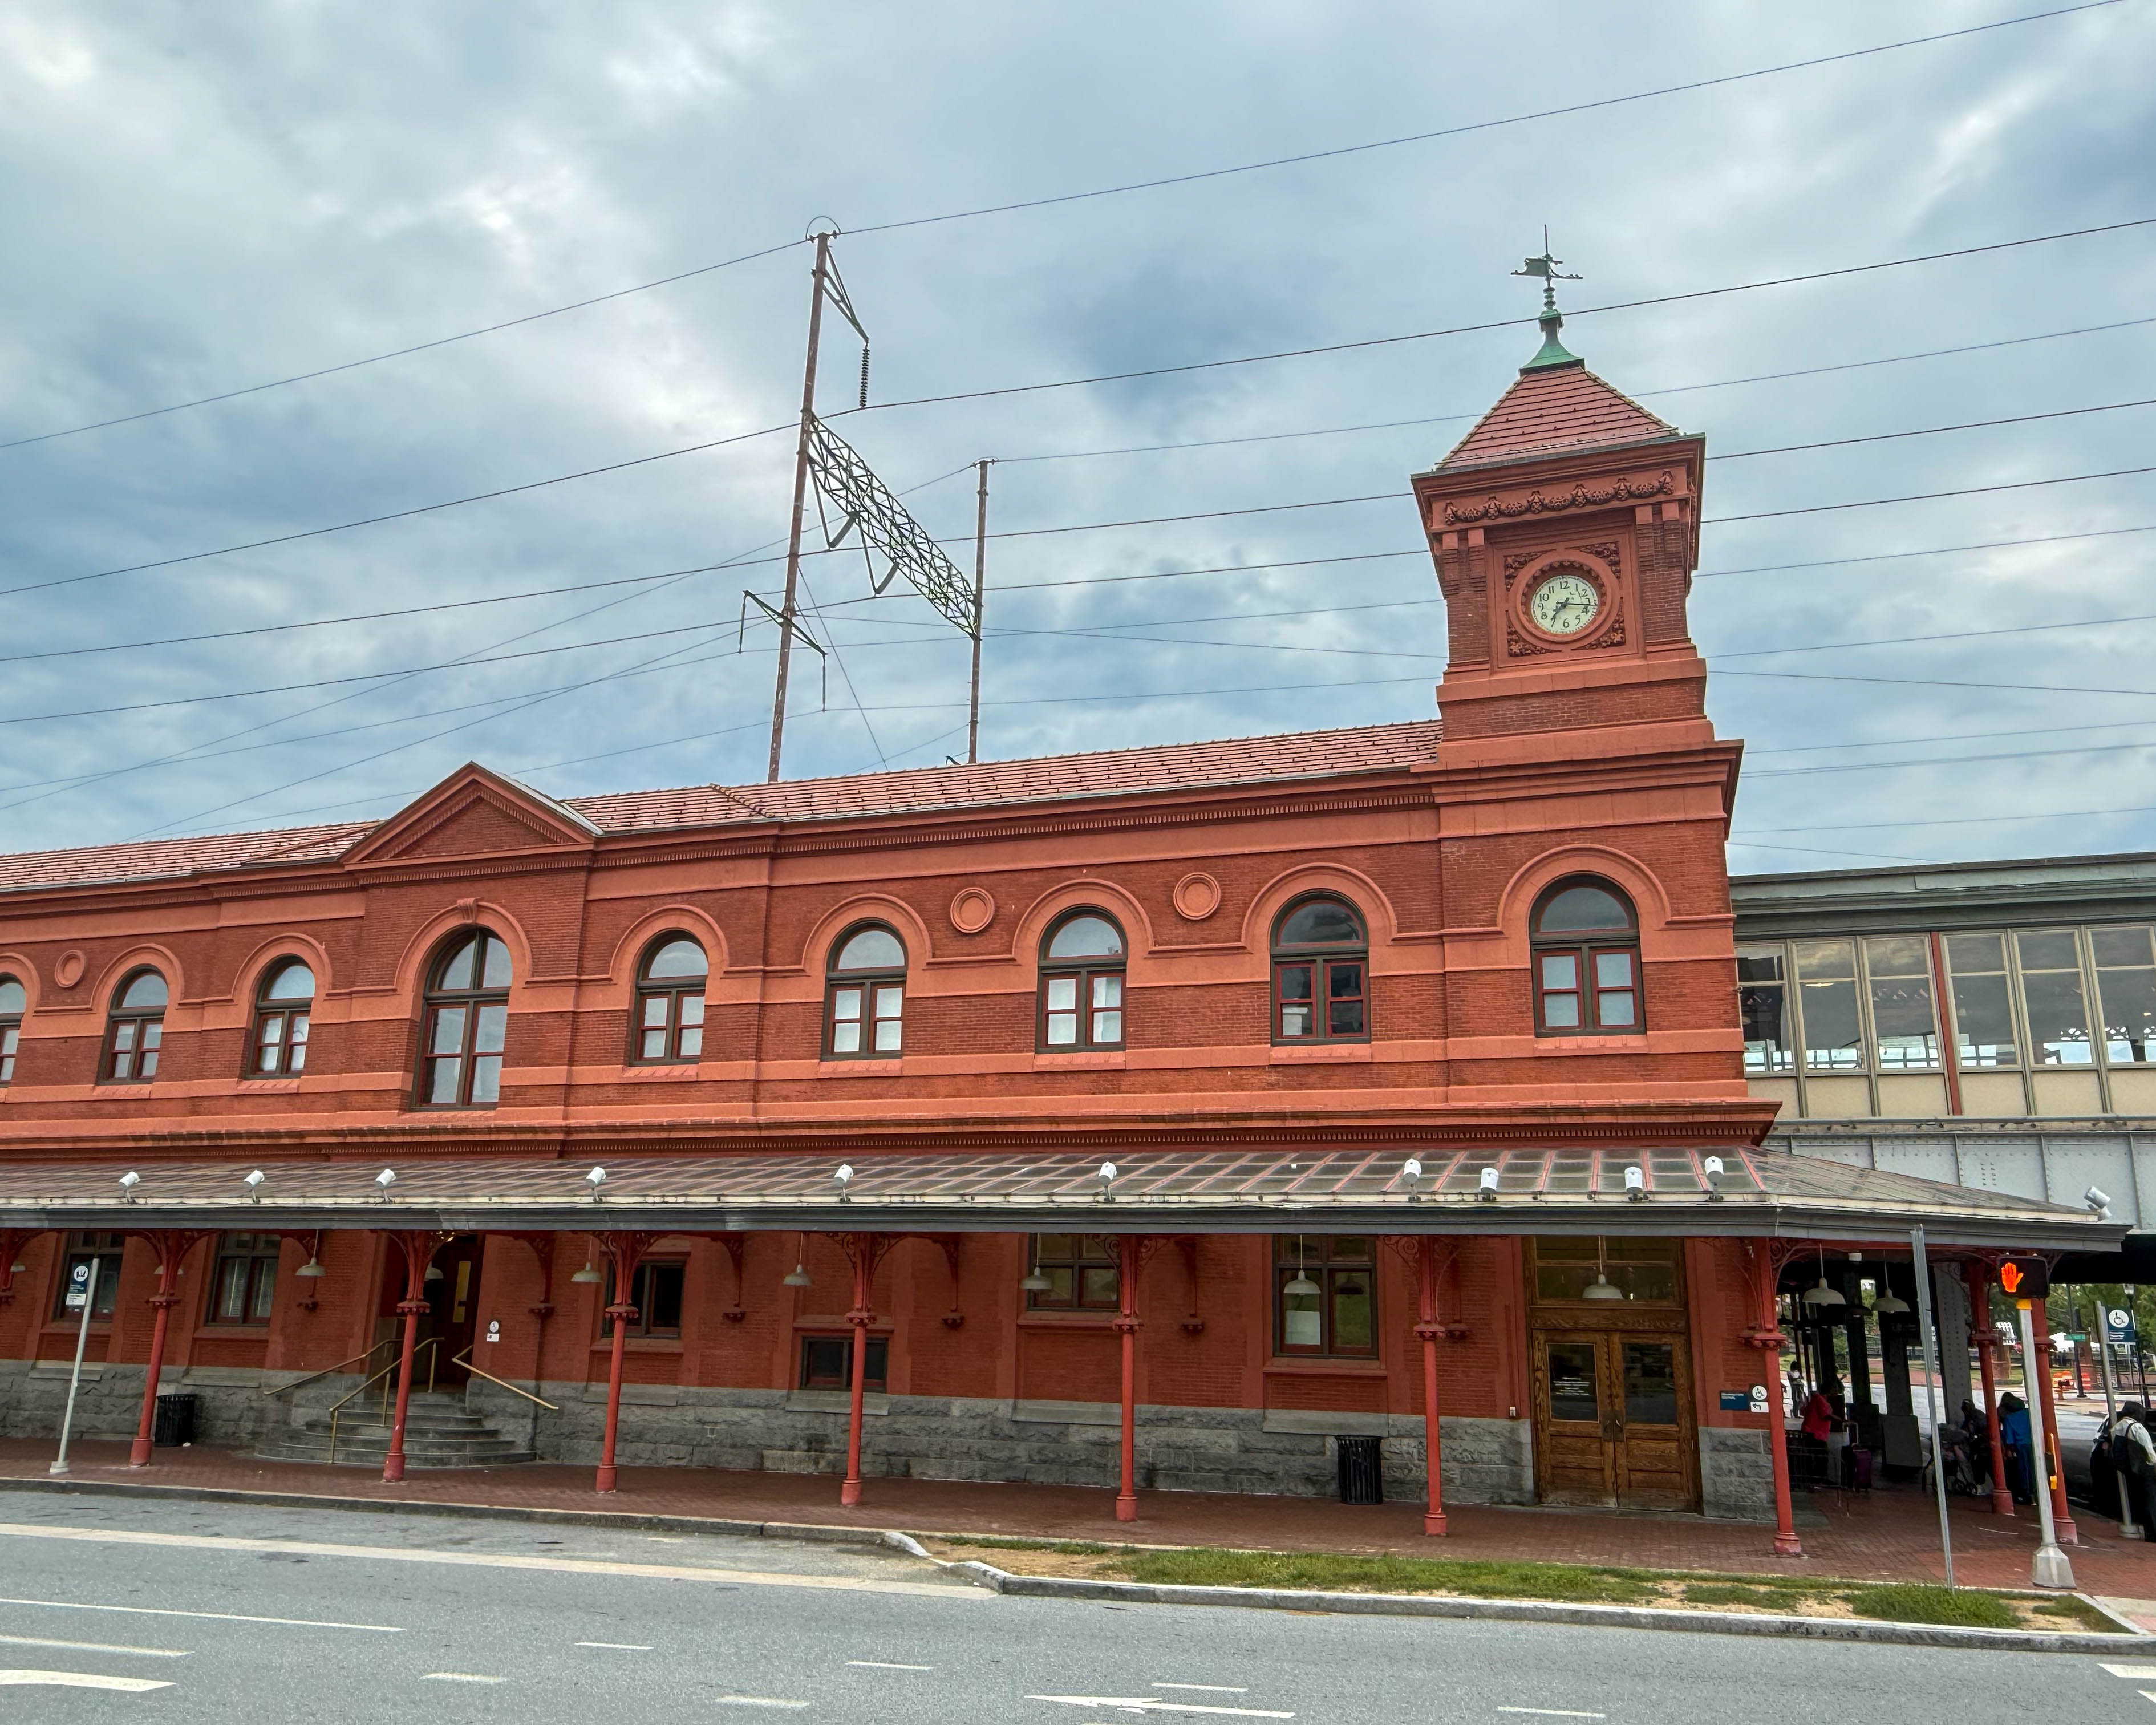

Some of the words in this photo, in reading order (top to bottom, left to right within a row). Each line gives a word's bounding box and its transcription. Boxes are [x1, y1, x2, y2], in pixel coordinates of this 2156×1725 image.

[1560, 581, 1570, 589] 12
[1575, 583, 1578, 592] 1
[1540, 593, 1549, 602] 10
[1538, 603, 1544, 612] 9
[1563, 618, 1570, 629] 6
[1575, 615, 1580, 626] 5
